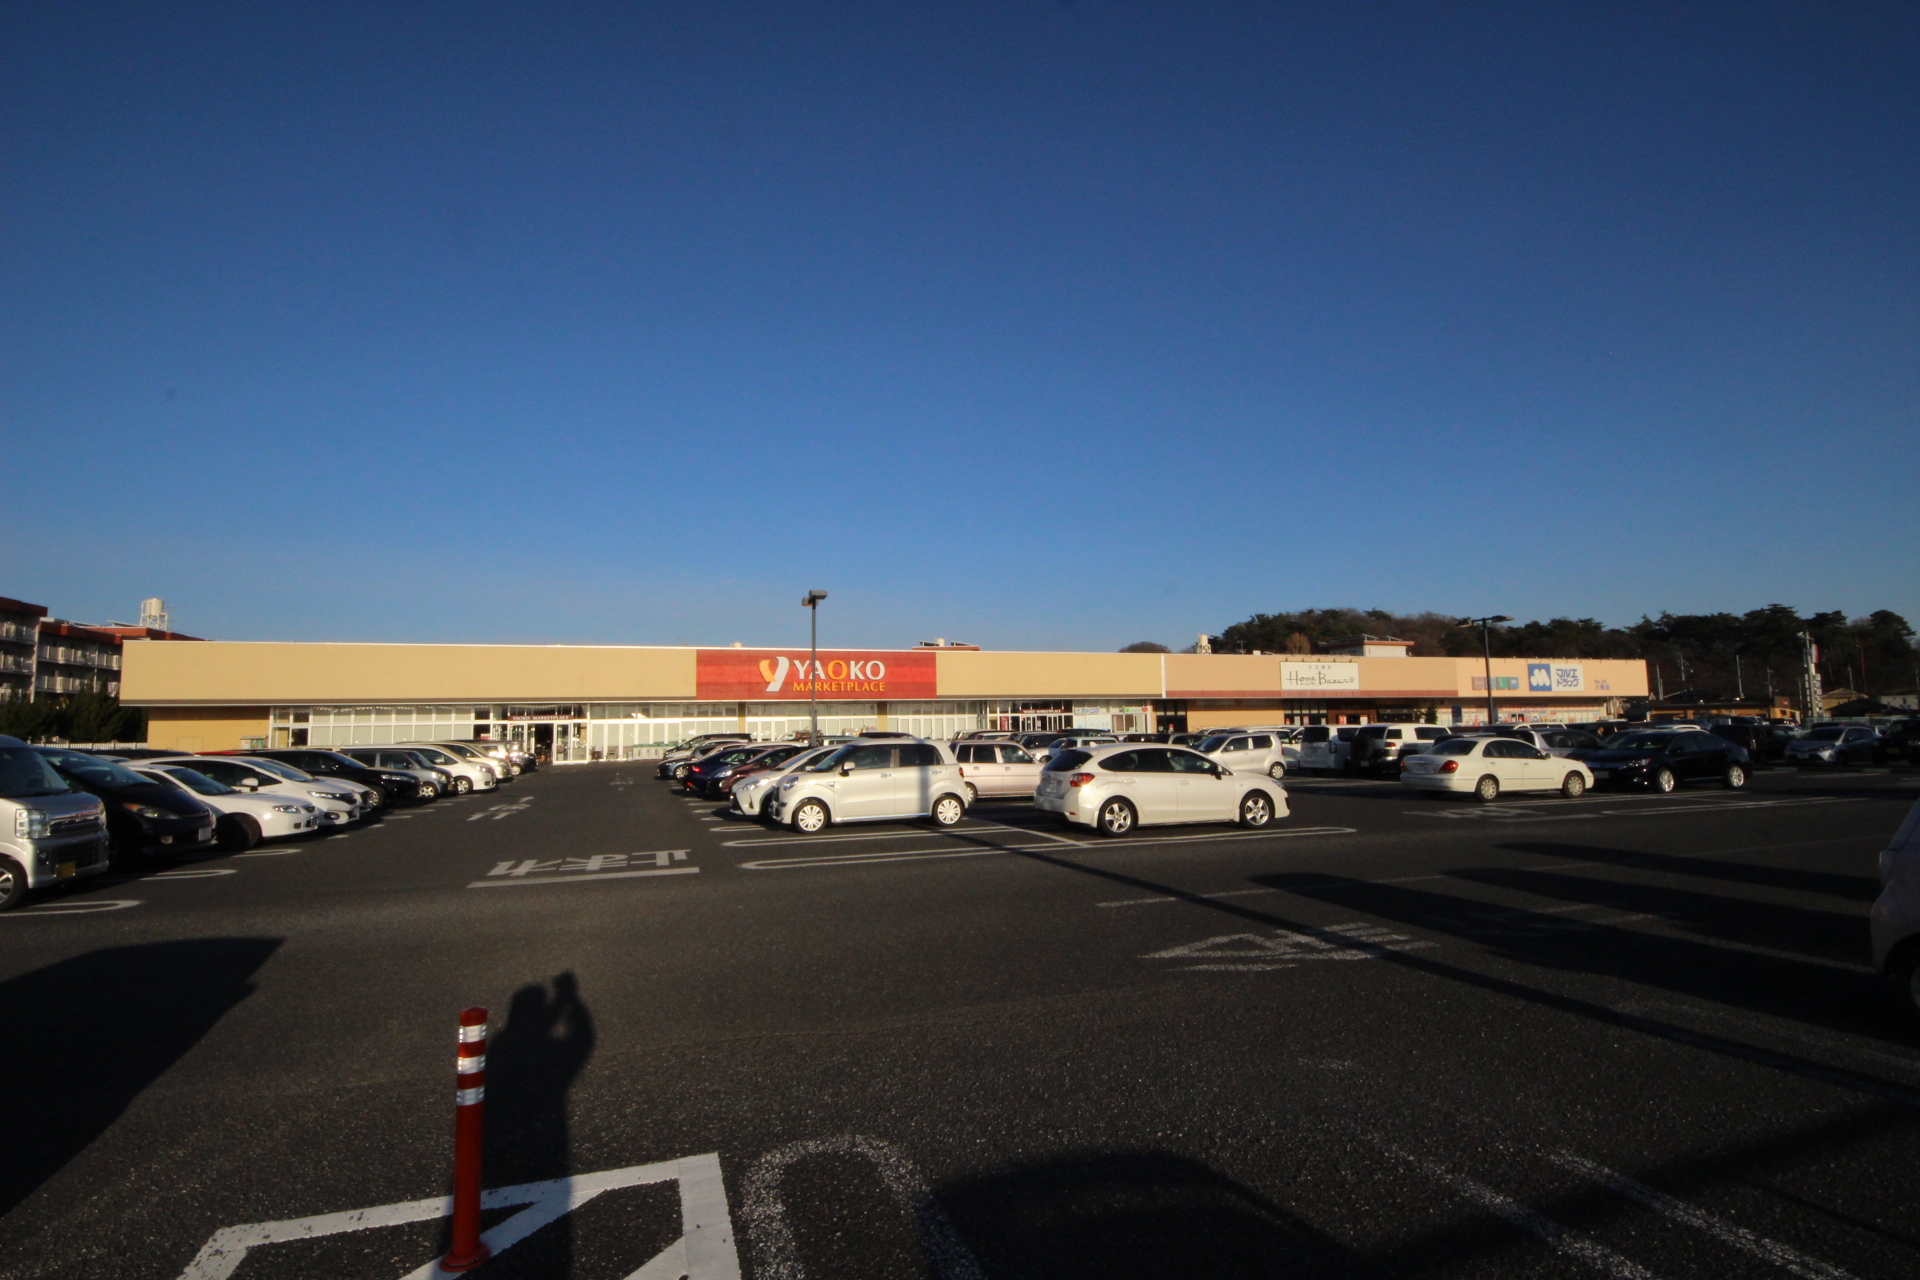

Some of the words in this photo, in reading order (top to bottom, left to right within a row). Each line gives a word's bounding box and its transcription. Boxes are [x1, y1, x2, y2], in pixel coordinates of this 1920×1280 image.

[793, 660, 886, 680] YAOKO
[1556, 668, 1578, 678] マルエ
[1286, 670, 1316, 686] Home
[1317, 670, 1348, 685] Bazar
[1556, 678, 1579, 687] ドラッグ
[793, 681, 886, 692] MARKETPLACE
[486, 849, 691, 877] 止まれ
